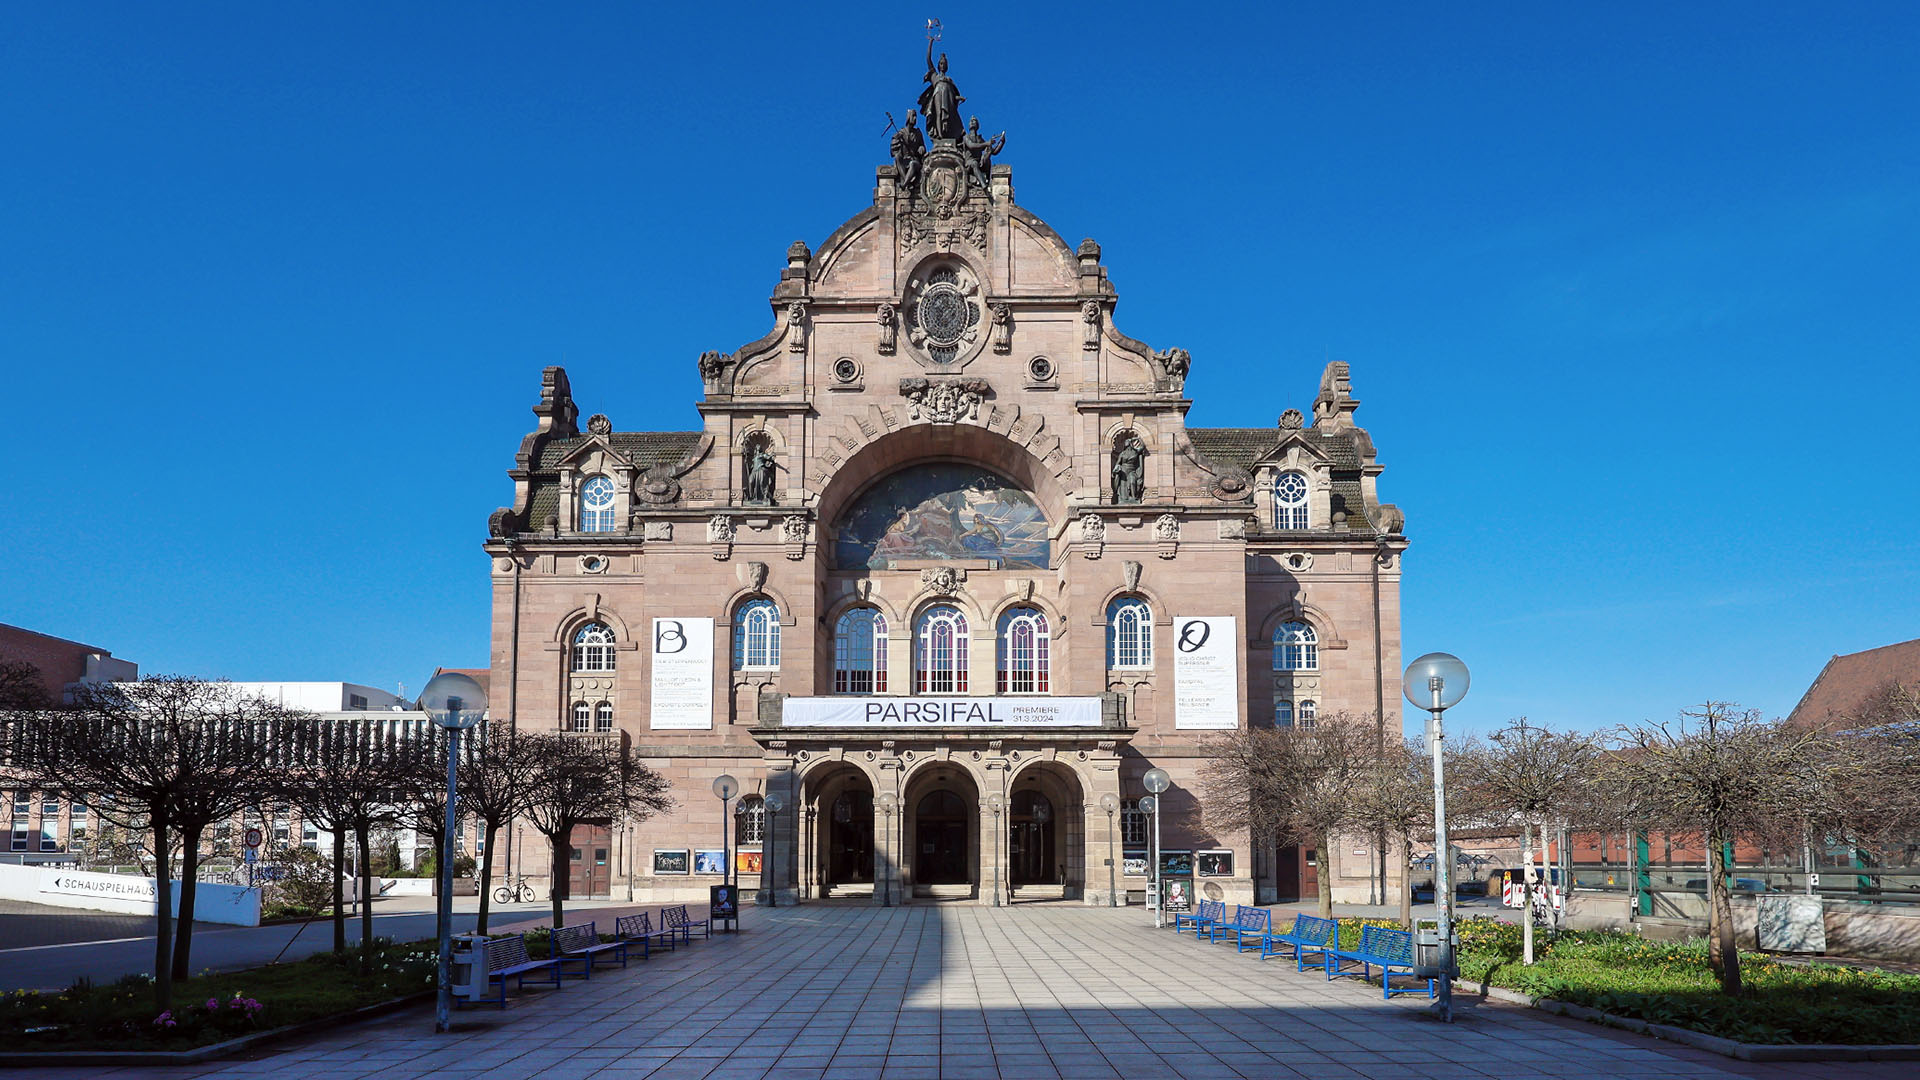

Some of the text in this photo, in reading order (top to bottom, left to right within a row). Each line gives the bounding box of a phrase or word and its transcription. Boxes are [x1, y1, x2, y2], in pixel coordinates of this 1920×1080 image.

[656, 621, 687, 653] B
[865, 702, 1003, 723] PARSIFAL
[1013, 706, 1060, 714] PREMIERE
[64, 878, 156, 896] SCHAUSPIELHAUS
